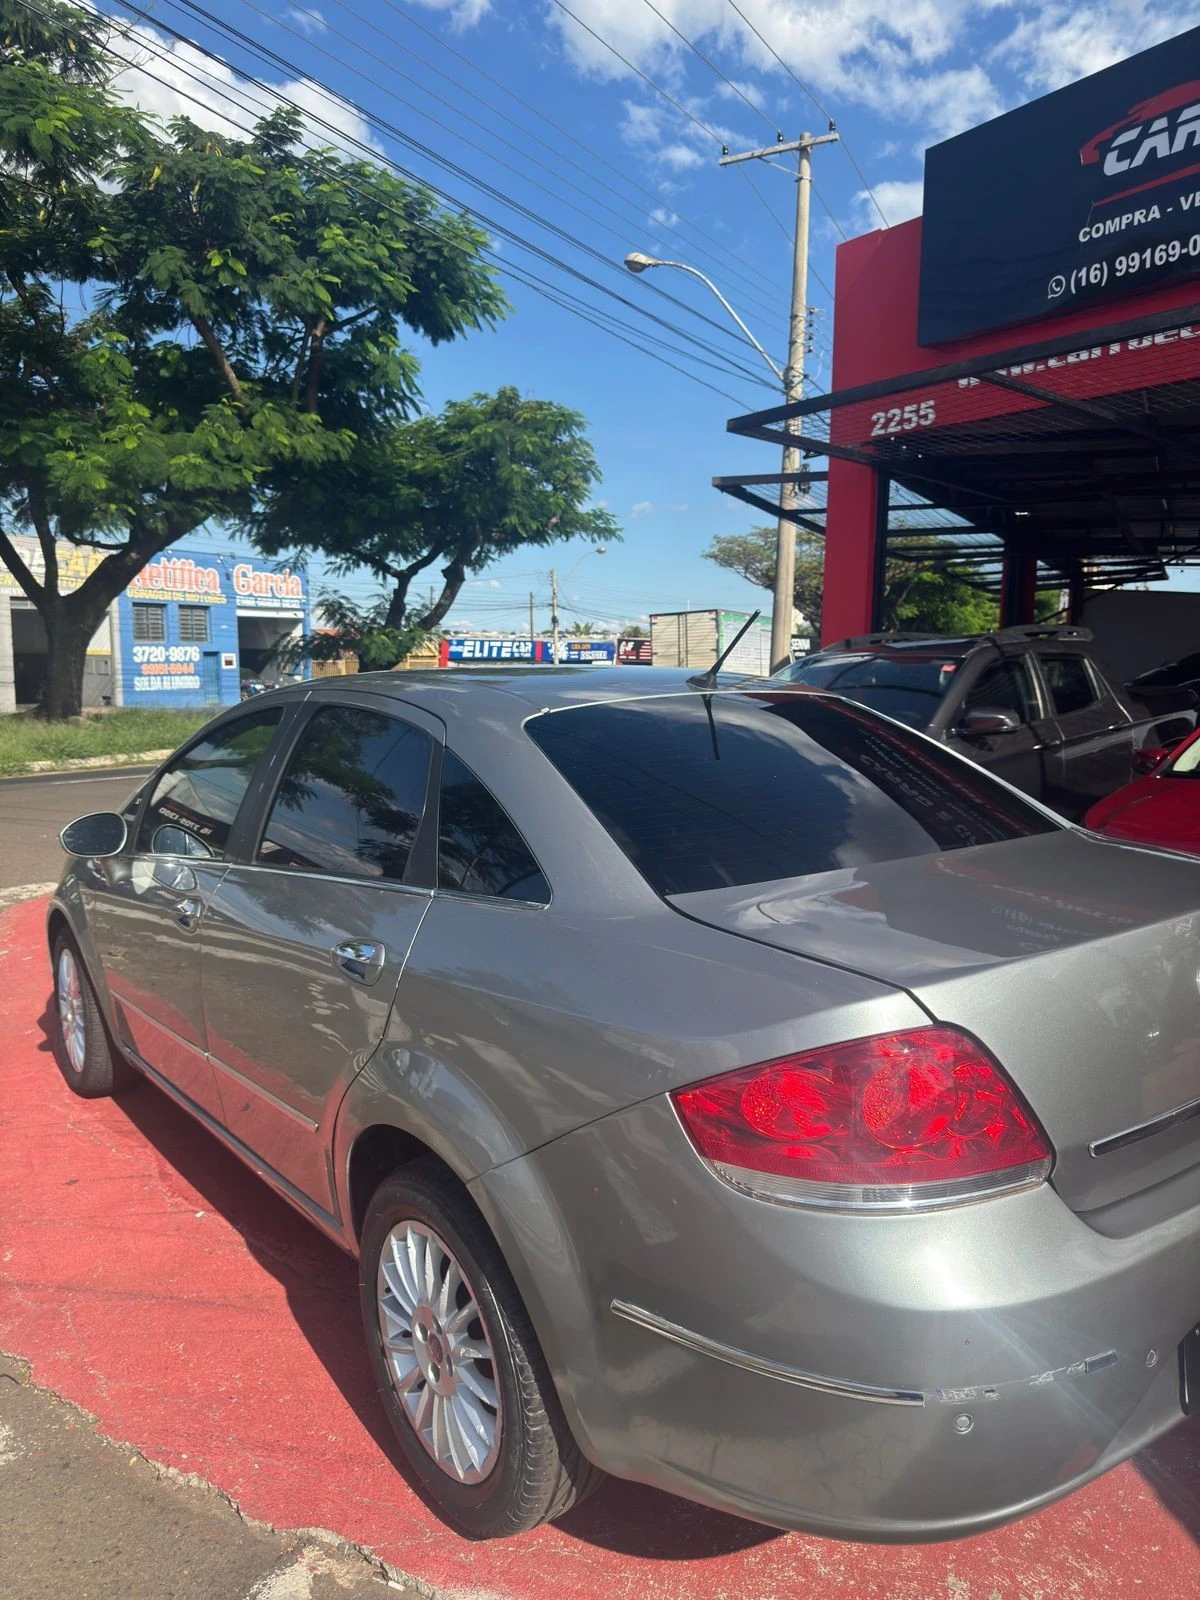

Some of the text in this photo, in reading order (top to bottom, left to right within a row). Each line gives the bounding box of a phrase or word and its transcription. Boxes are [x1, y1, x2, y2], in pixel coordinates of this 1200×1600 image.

[1079, 205, 1161, 243] COMPRA
[1071, 234, 1200, 294] (16) 99169-0
[871, 400, 936, 437] 2255
[132, 645, 200, 663] 3720-9876
[462, 640, 512, 657] ELITE
